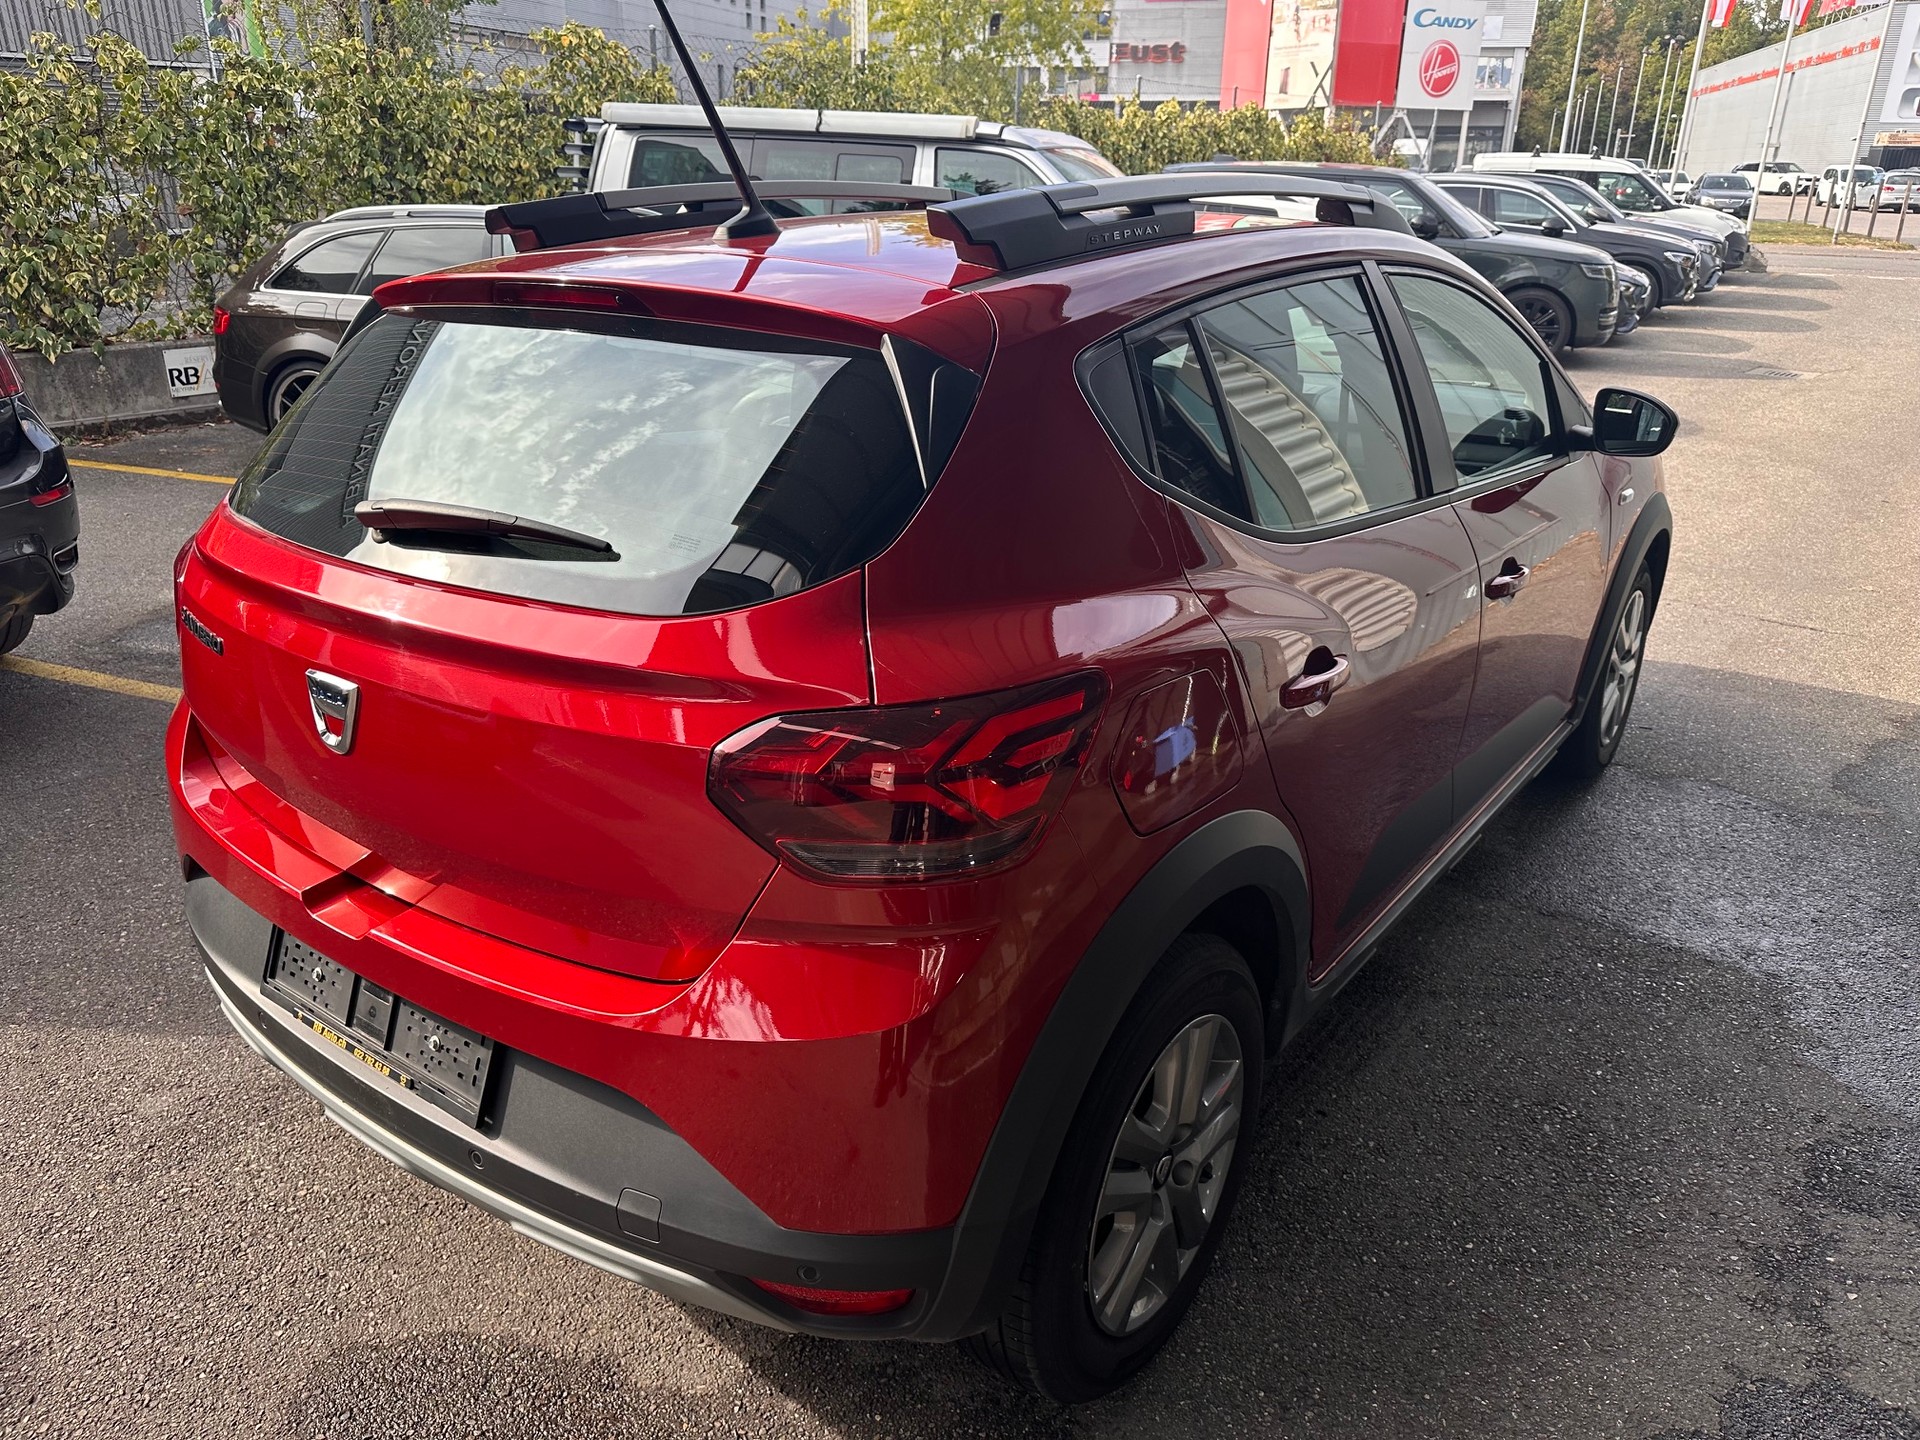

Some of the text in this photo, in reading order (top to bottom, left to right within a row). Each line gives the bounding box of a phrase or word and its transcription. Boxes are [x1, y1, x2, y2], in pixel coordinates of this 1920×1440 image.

[1413, 8, 1478, 29] CANDY
[1089, 224, 1161, 245] STEPWAY
[168, 366, 200, 387] RB
[312, 1020, 322, 1034] RB
